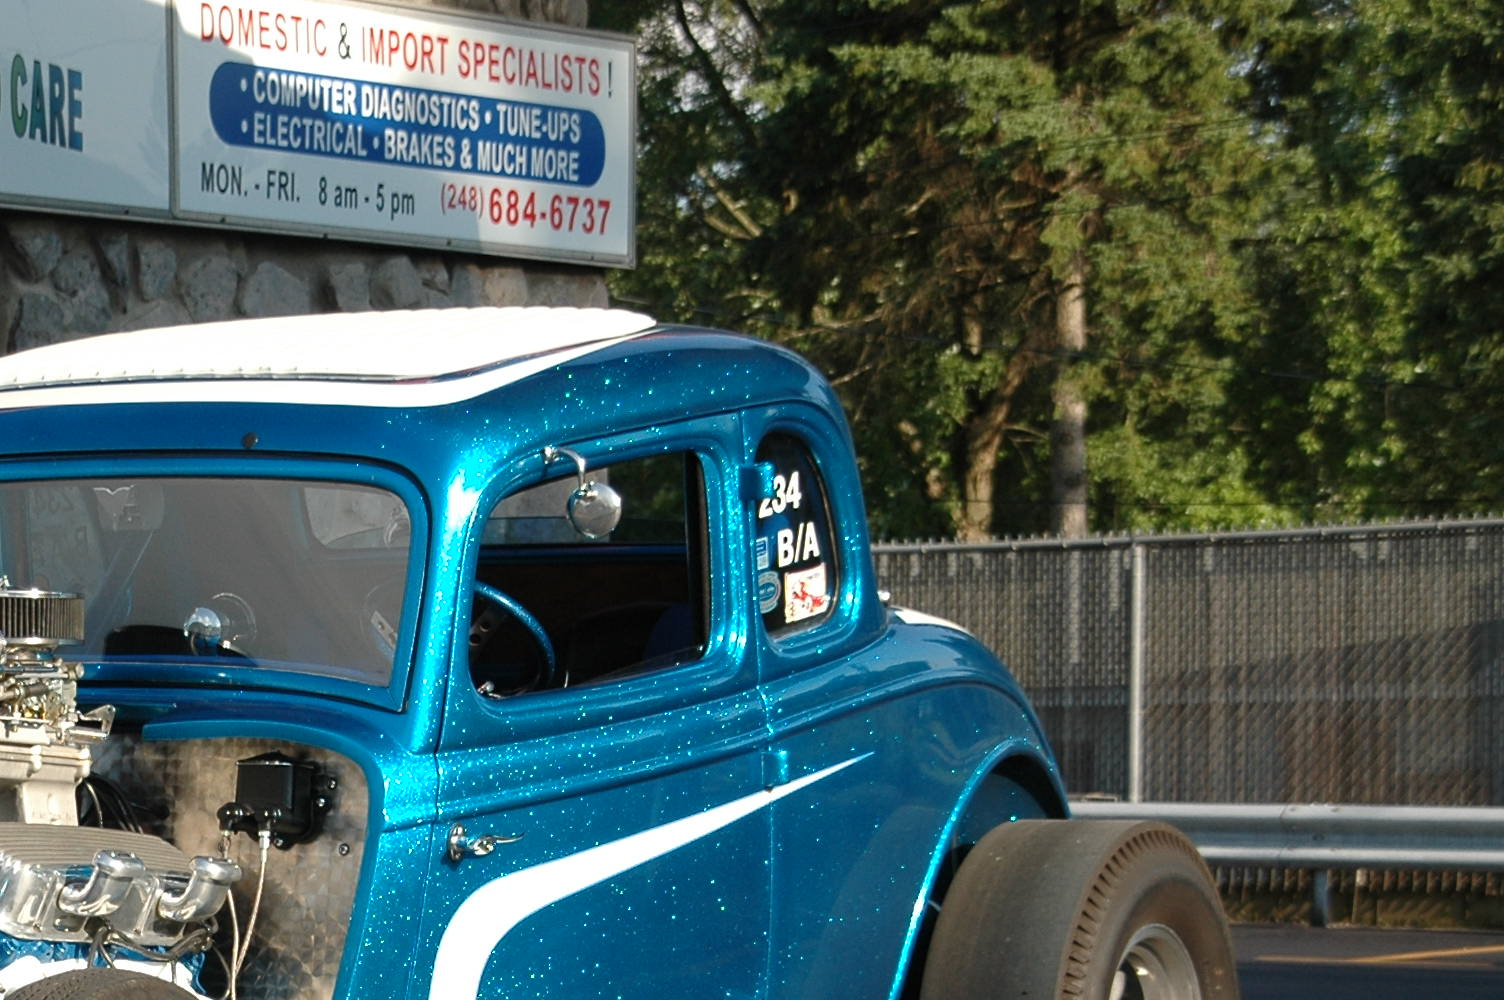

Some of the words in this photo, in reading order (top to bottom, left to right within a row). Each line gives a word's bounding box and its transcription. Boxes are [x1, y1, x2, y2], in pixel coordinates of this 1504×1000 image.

[199, 3, 327, 56] DOMESTIC
[338, 22, 352, 60] &
[361, 26, 449, 76] IMPORT
[11, 54, 84, 153] CARE
[253, 71, 357, 116] COMPUTER
[361, 85, 481, 131] DIAGNOSTICS
[497, 104, 581, 143] TUNE-UPS
[253, 112, 368, 158] ELECTRICAL
[384, 130, 455, 168] BRAKES
[460, 141, 472, 169] &
[477, 140, 528, 177] MUCH
[531, 150, 580, 182] MORE
[201, 162, 248, 197] MON.
[266, 170, 301, 203] FRI.
[318, 176, 328, 207] 8
[334, 187, 359, 210] am
[376, 184, 386, 216] 5
[390, 191, 415, 222] pm
[440, 184, 484, 219] (248)
[489, 189, 612, 236] 684-6737
[778, 522, 820, 568] B/A
